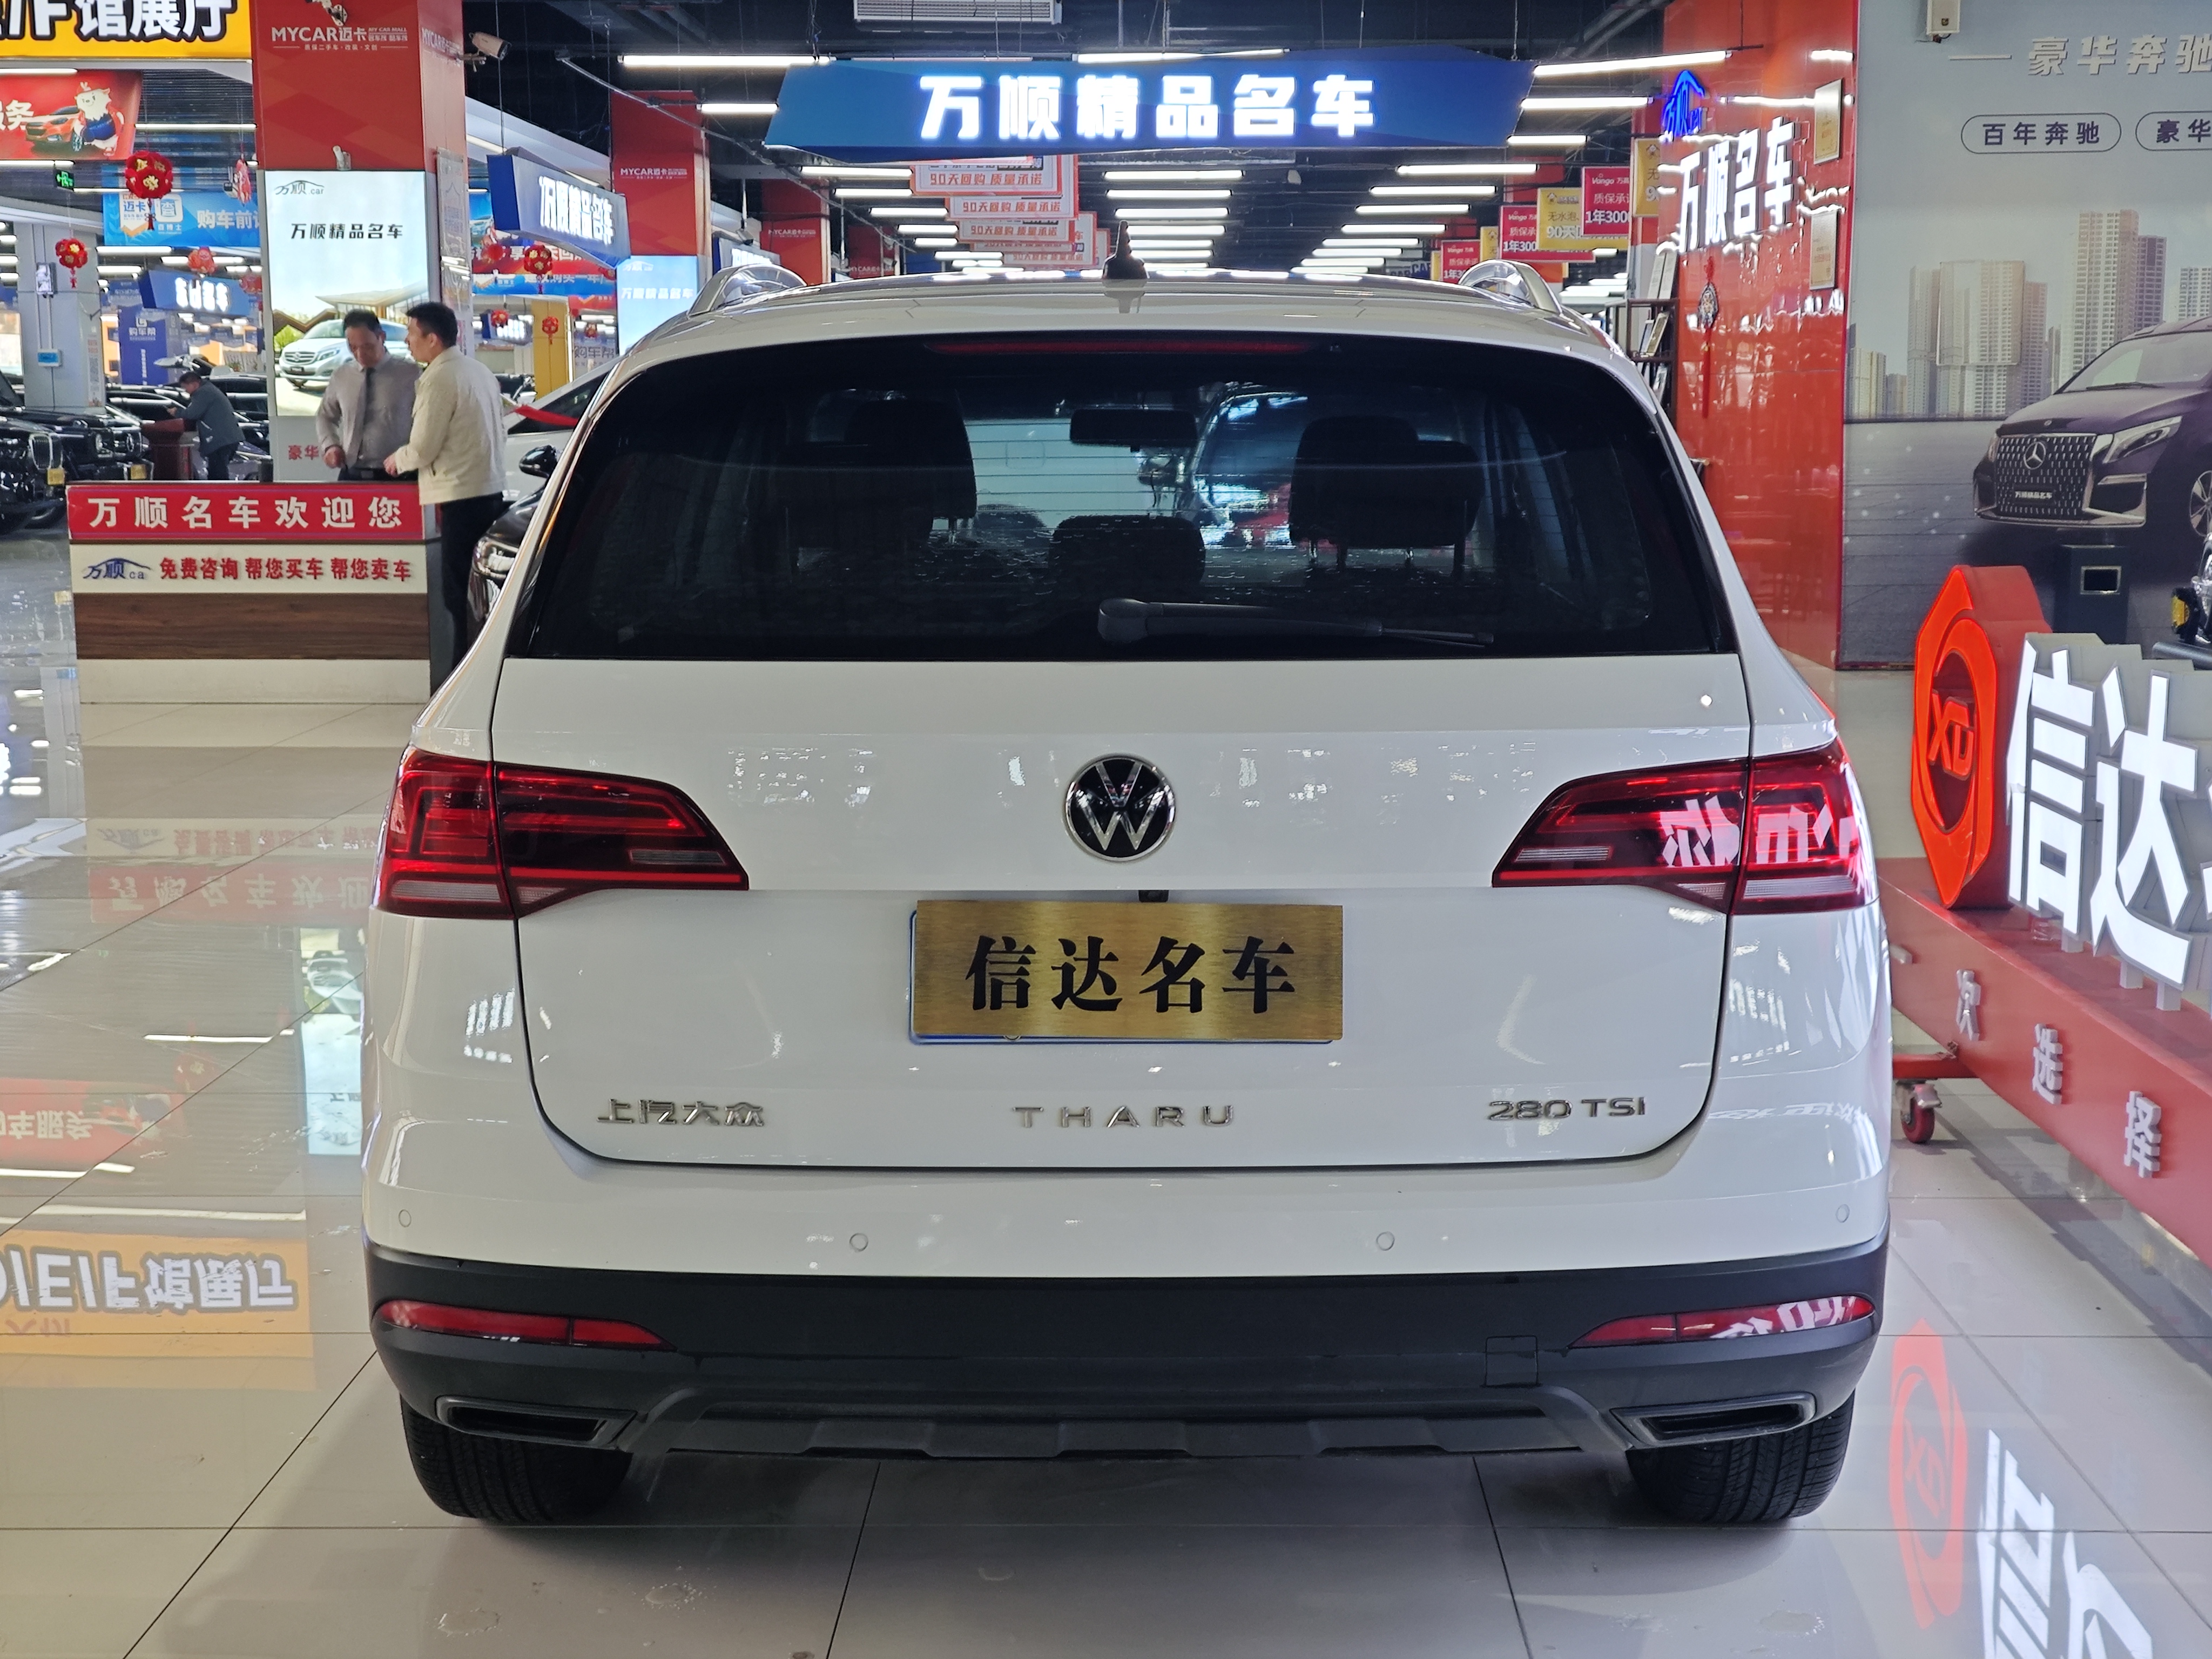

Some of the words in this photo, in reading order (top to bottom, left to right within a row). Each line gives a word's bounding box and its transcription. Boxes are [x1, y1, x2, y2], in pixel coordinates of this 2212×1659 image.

[2028, 35, 2212, 76] 豪华奔驰
[920, 74, 1374, 139] 万顺精品名车
[1982, 120, 2100, 146] 百年奔驰
[2156, 118, 2212, 144] 豪华
[930, 173, 985, 185] 90天回购
[990, 173, 1042, 185] 质量承诺
[1677, 116, 1795, 253] 万顺名车
[963, 201, 1011, 212] 90天回购
[1016, 201, 1061, 212] 质量承诺
[291, 223, 403, 239] 万顺精品名车
[288, 445, 319, 460] 豪华
[87, 496, 402, 529] 万顺名车欢迎您
[160, 557, 239, 580] 免费咨询
[245, 557, 324, 581] 帮您买车
[331, 557, 412, 583] 帮您卖车
[2006, 638, 2212, 986] 信达
[966, 935, 1296, 1014] 信达名车
[596, 1098, 765, 1127] 上汽大众
[1013, 1105, 1235, 1128] THARU
[1487, 1100, 1573, 1121] 280
[1581, 1096, 1647, 1117] TSI
